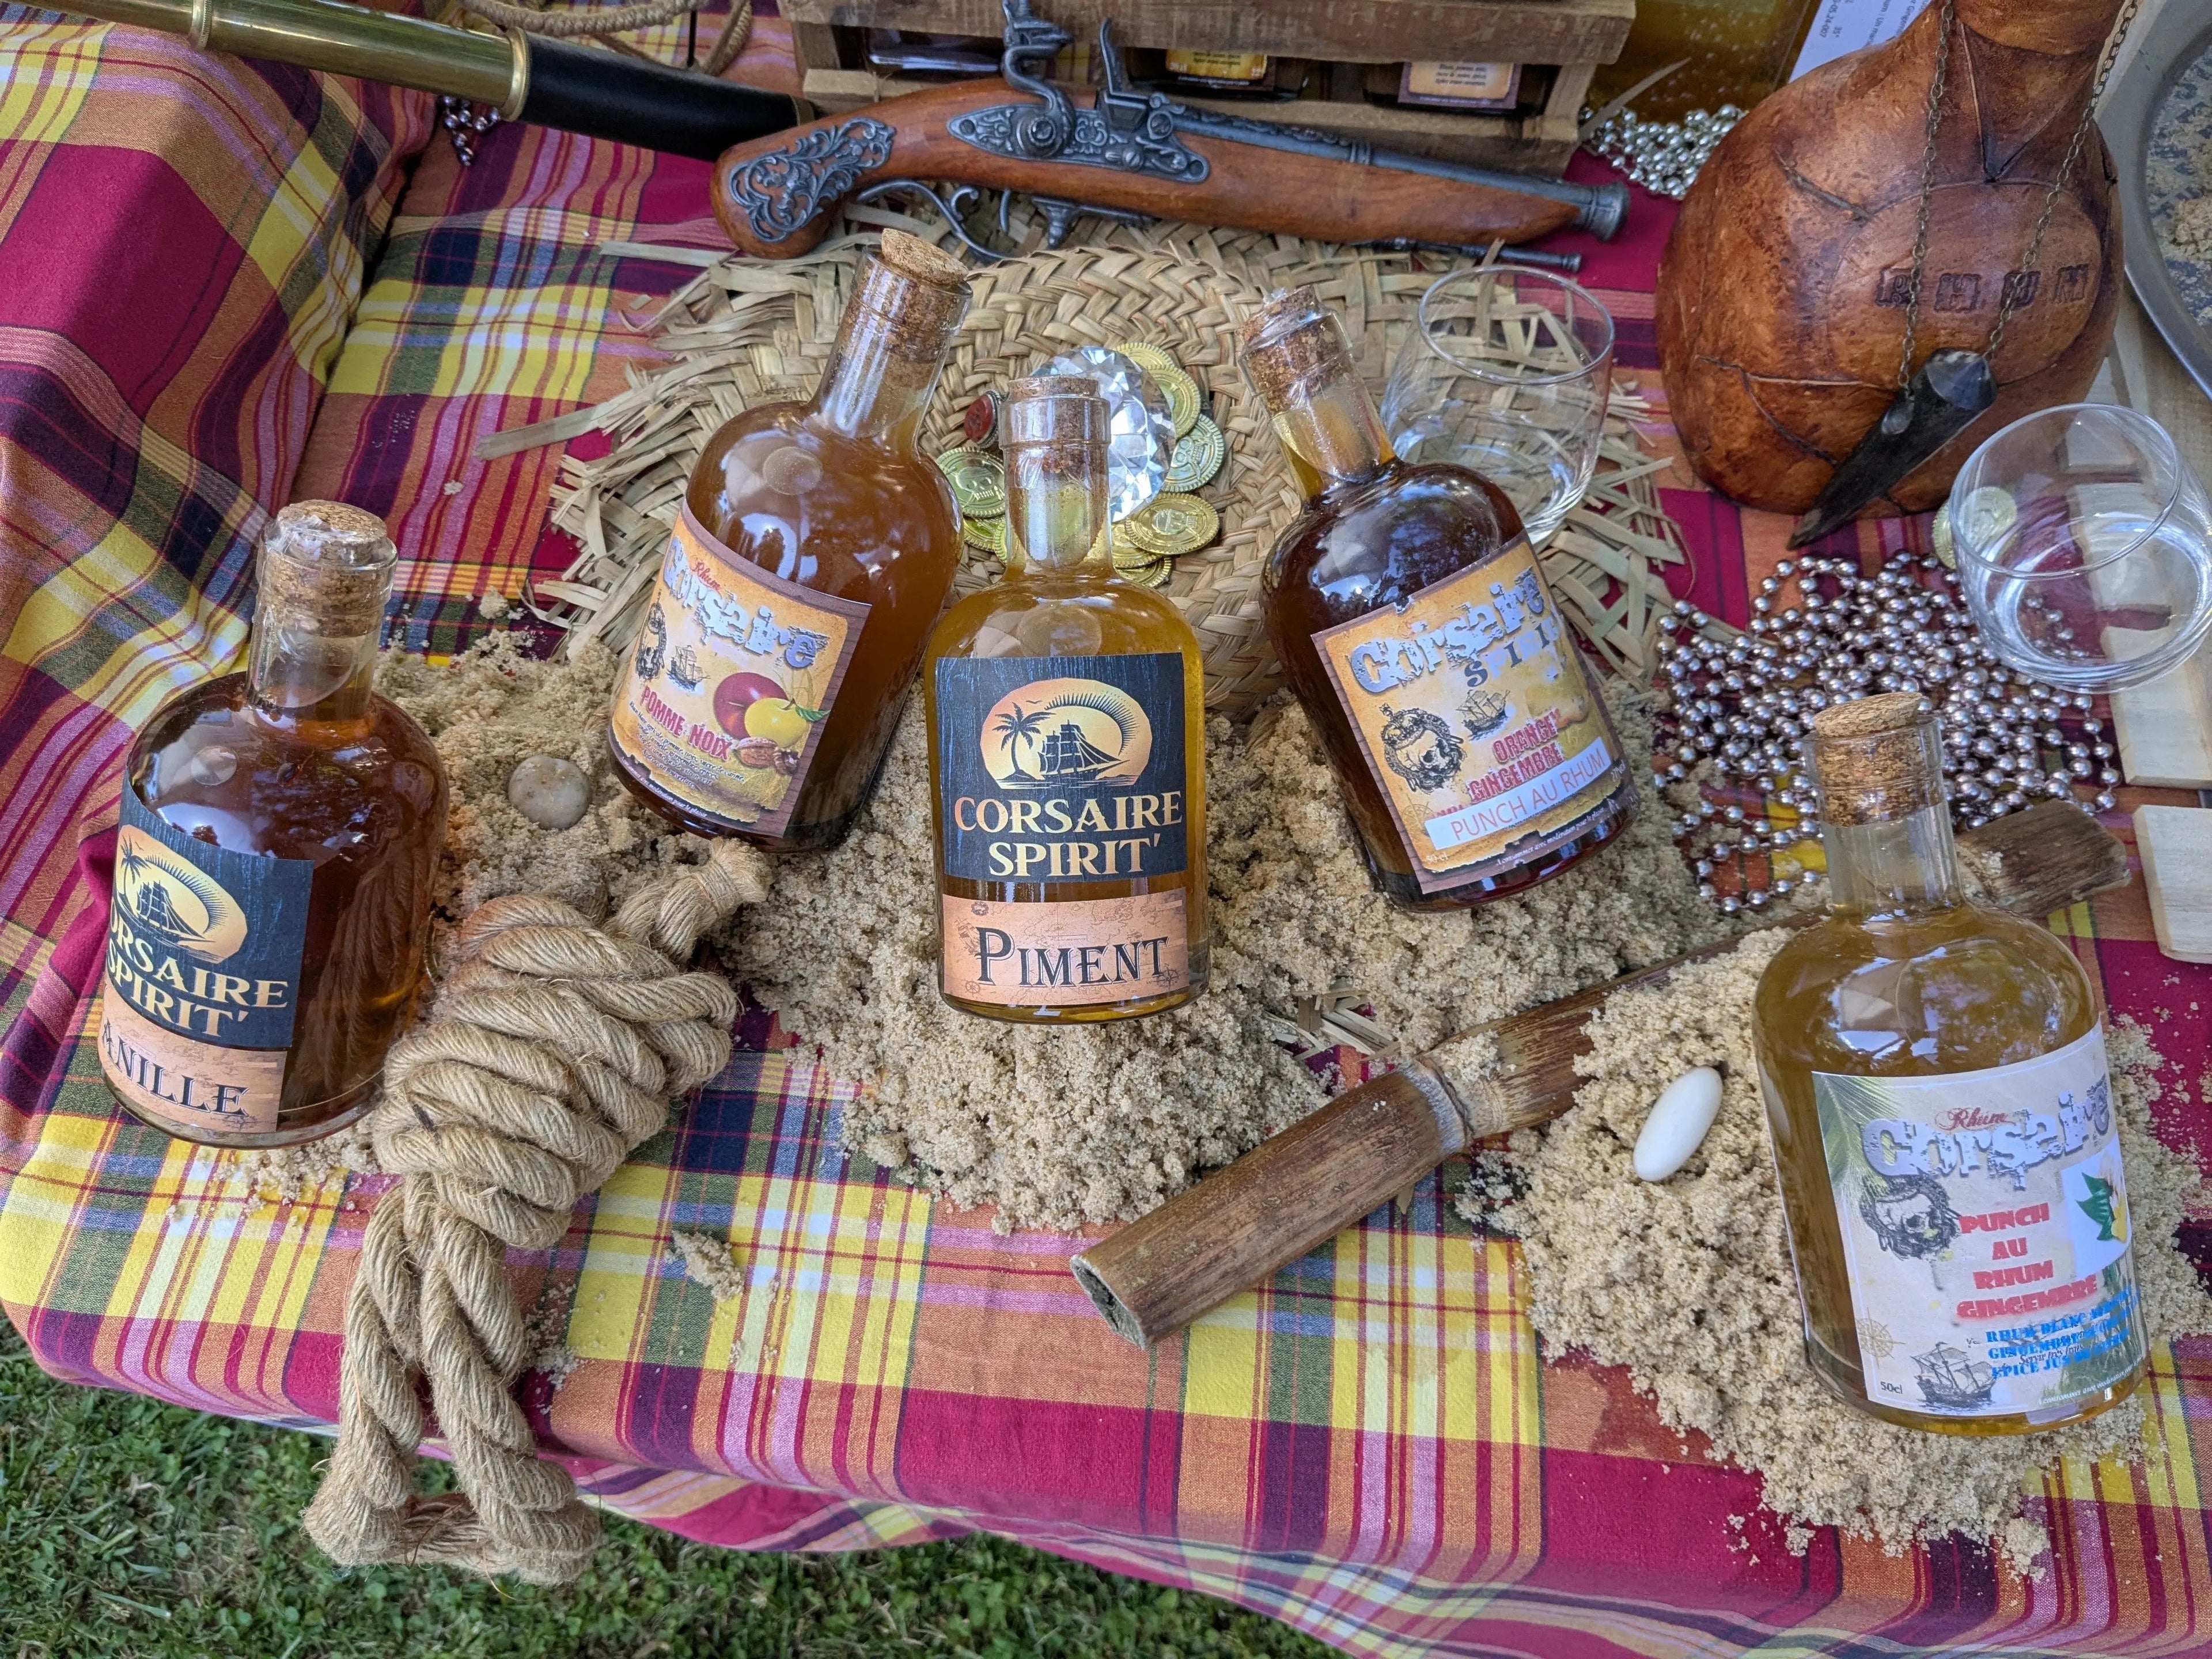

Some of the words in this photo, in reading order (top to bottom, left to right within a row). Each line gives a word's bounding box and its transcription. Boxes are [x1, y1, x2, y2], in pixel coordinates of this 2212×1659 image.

[691, 554, 721, 592] Rhum
[640, 685, 685, 737] POMME
[688, 724, 733, 761] NOIX
[1450, 796, 1528, 841] PUNCH
[1533, 779, 1558, 810] AU
[1560, 748, 1605, 793] RHUM
[1469, 741, 1565, 803] GINGEMBRE
[955, 791, 1184, 834] CORSAIRE
[989, 833, 1161, 877] SPIRIT'
[110, 896, 289, 1009] ORSAIRE
[975, 927, 1171, 988] PIMENT
[107, 938, 249, 1037] SPIRIT'
[103, 1017, 250, 1118] ANILLE
[1936, 1107, 2016, 1131] Rhum
[1960, 1202, 2051, 1234] PUNCH
[1992, 1237, 2029, 1261] AU
[1956, 1275, 2098, 1320] GINGEMBRE
[1973, 1259, 2055, 1291] RHUM
